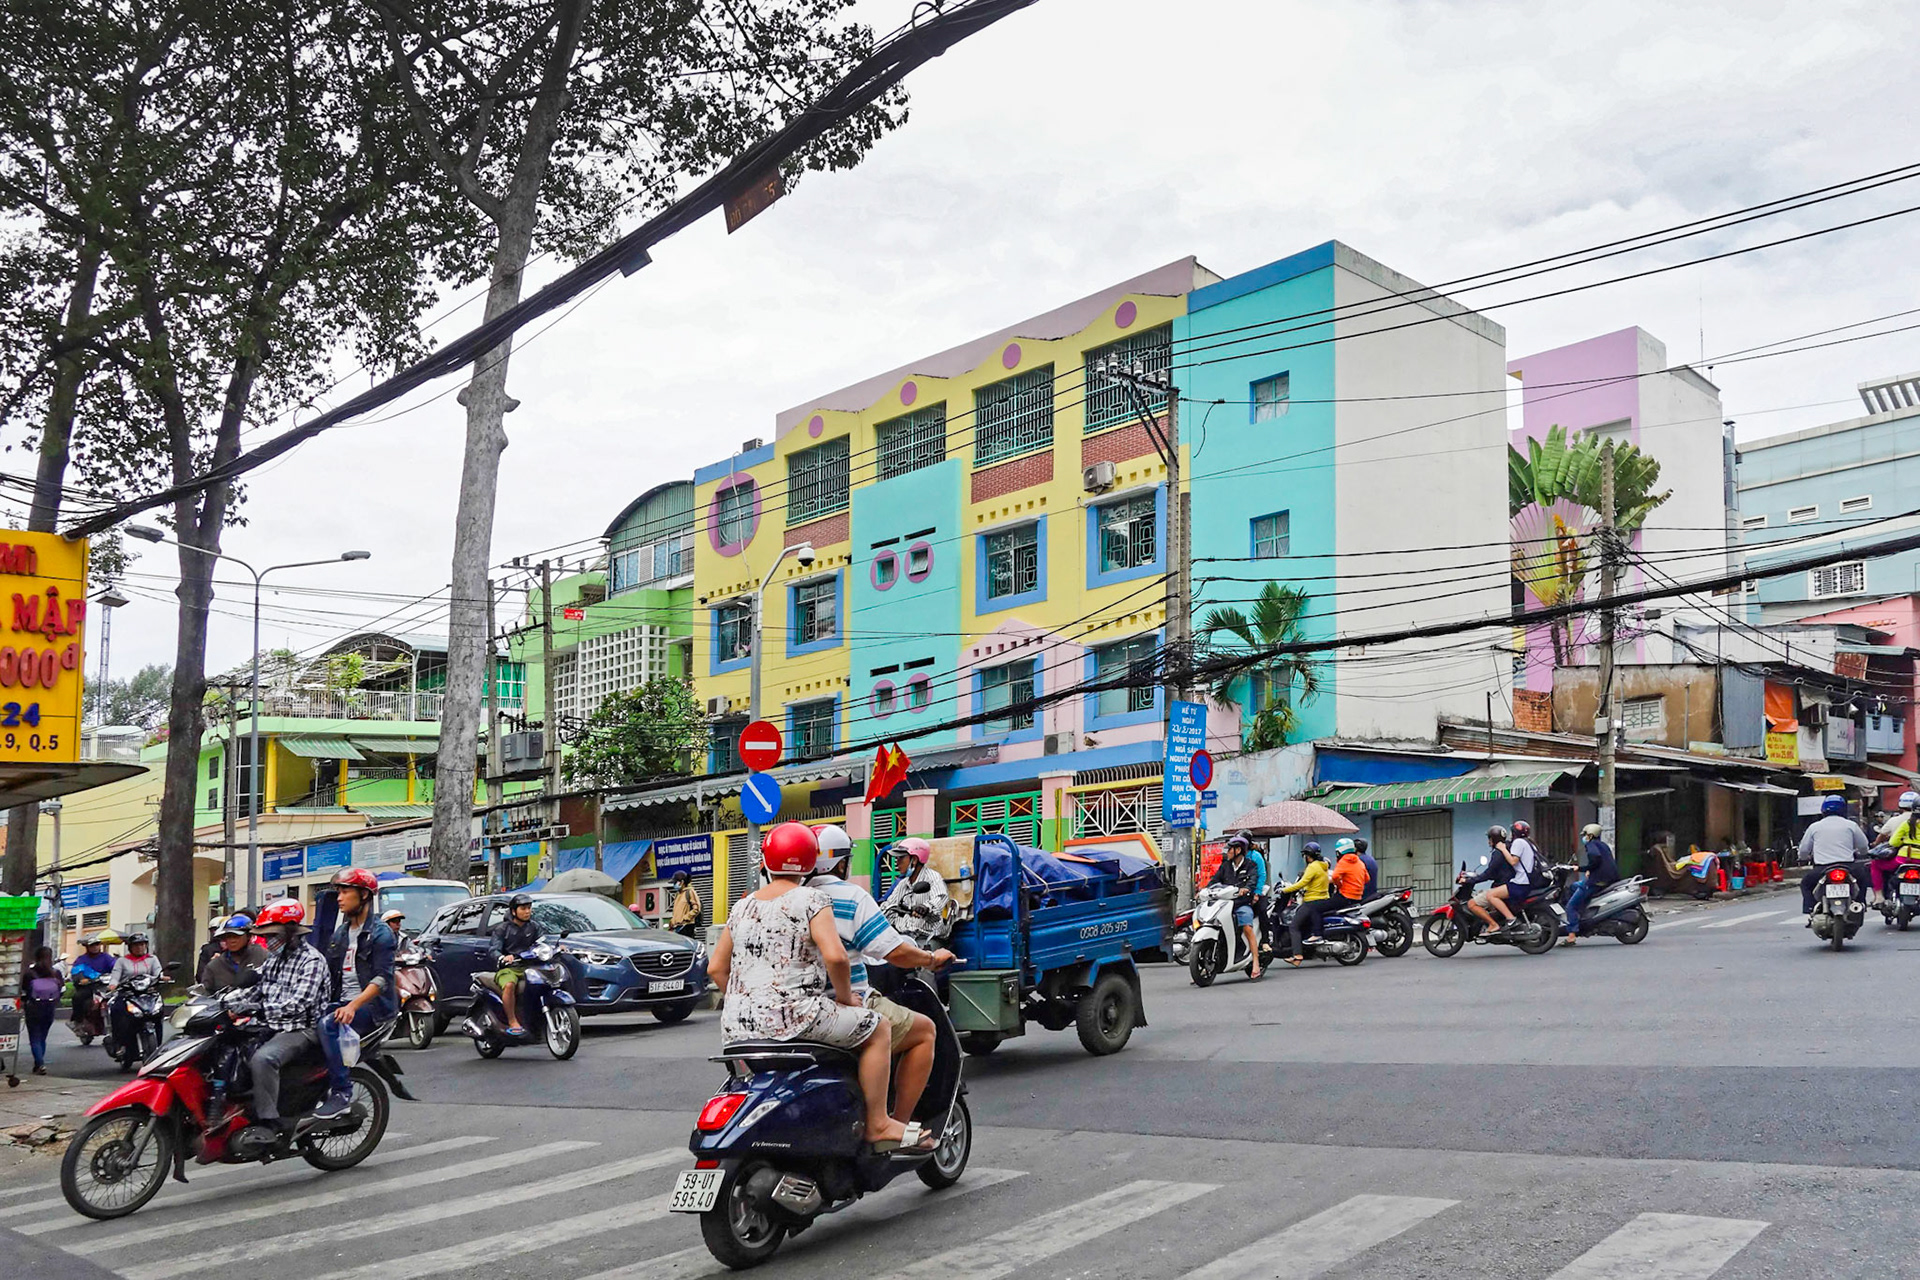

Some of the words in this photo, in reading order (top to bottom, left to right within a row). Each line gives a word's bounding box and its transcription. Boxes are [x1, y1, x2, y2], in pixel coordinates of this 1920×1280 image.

[11, 586, 86, 642] MẬP
[1, 701, 41, 728] 24
[1181, 715, 1196, 725] NGÀY
[29, 734, 59, 752] Q.5
[1172, 734, 1188, 744] VÒNG
[1171, 774, 1182, 782] THI
[1171, 785, 1185, 794] HẠN
[1178, 793, 1192, 802] CÁC
[645, 892, 655, 912] B
[672, 1191, 715, 1208] 595.40
